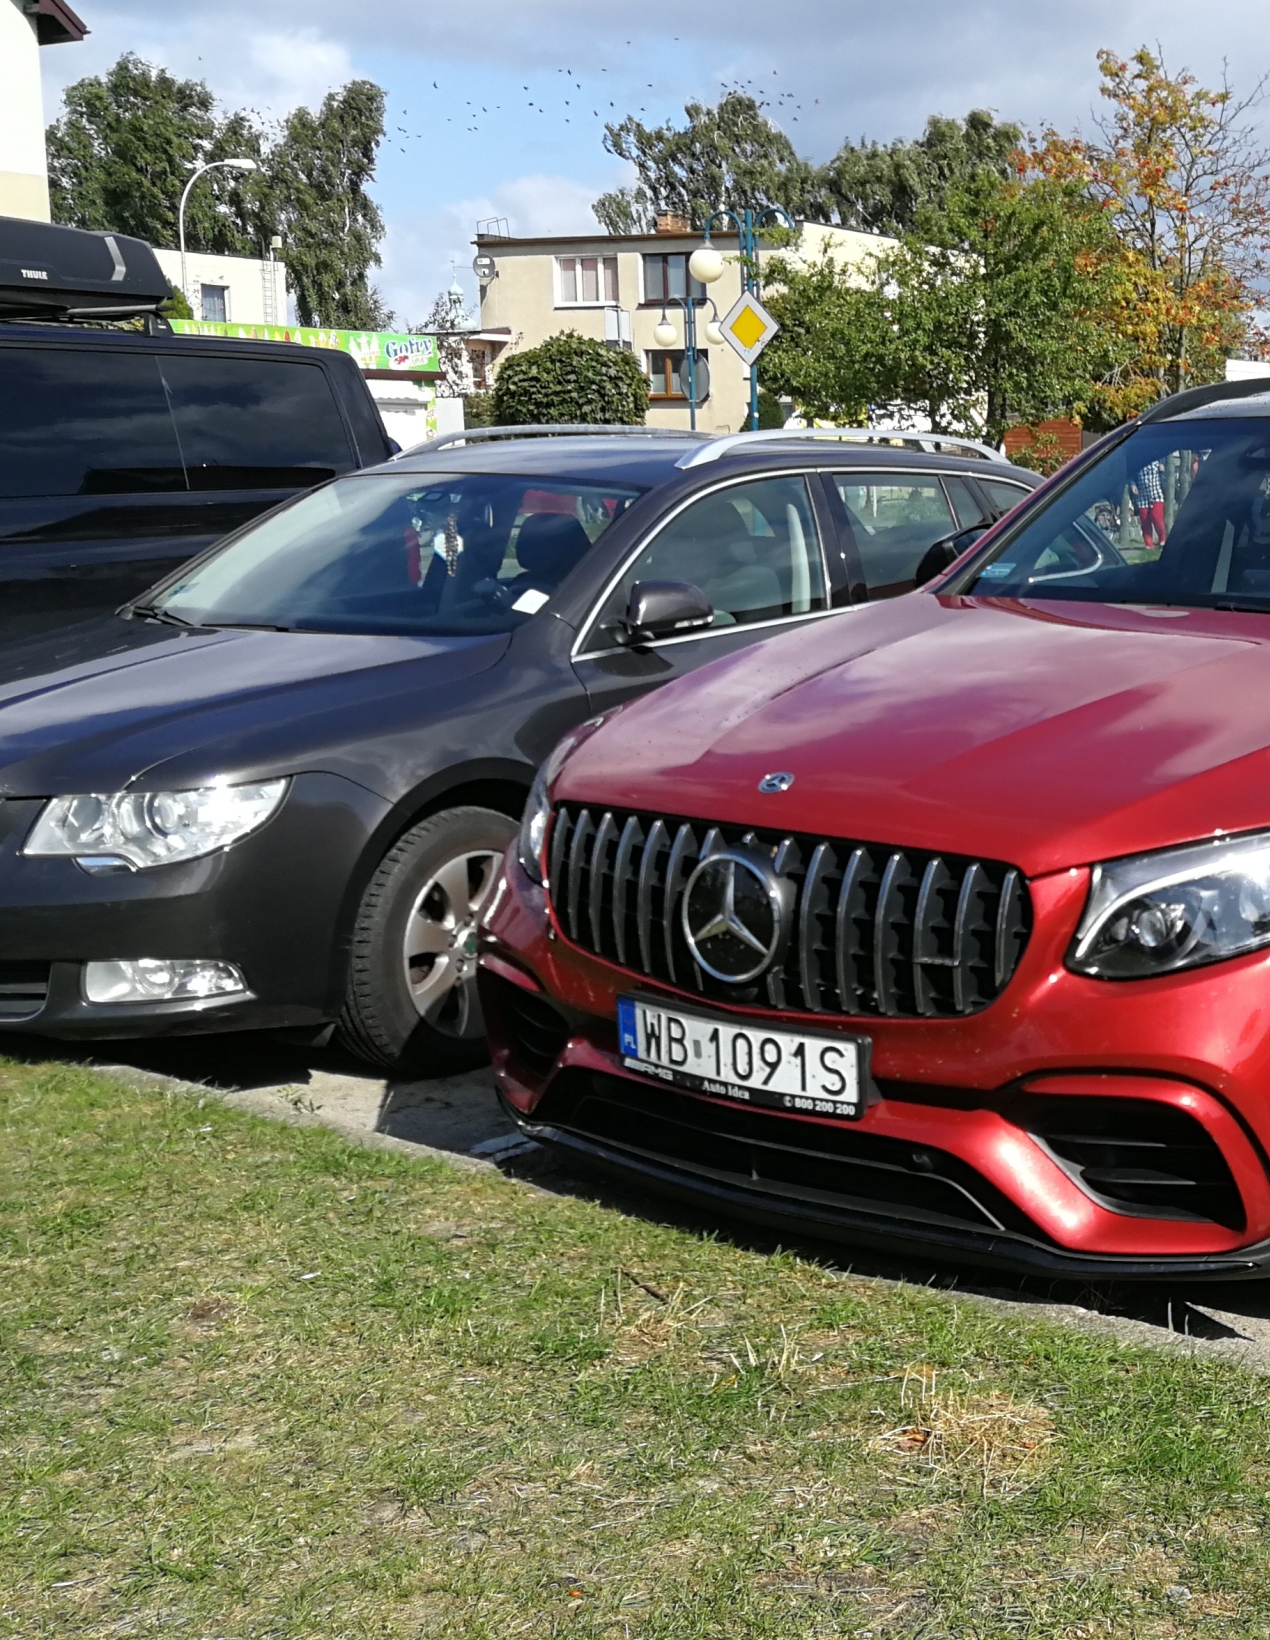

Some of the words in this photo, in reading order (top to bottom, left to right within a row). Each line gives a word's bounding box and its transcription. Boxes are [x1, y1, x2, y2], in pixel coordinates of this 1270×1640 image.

[20, 269, 49, 280] THULE
[386, 338, 432, 358] Gofry
[643, 1009, 689, 1067] WB
[708, 1027, 848, 1096] 1091S
[702, 1080, 726, 1095] Auto
[727, 1084, 750, 1100] Idea
[794, 1097, 814, 1110] 800
[815, 1100, 834, 1113] 200
[835, 1103, 856, 1116] 200
